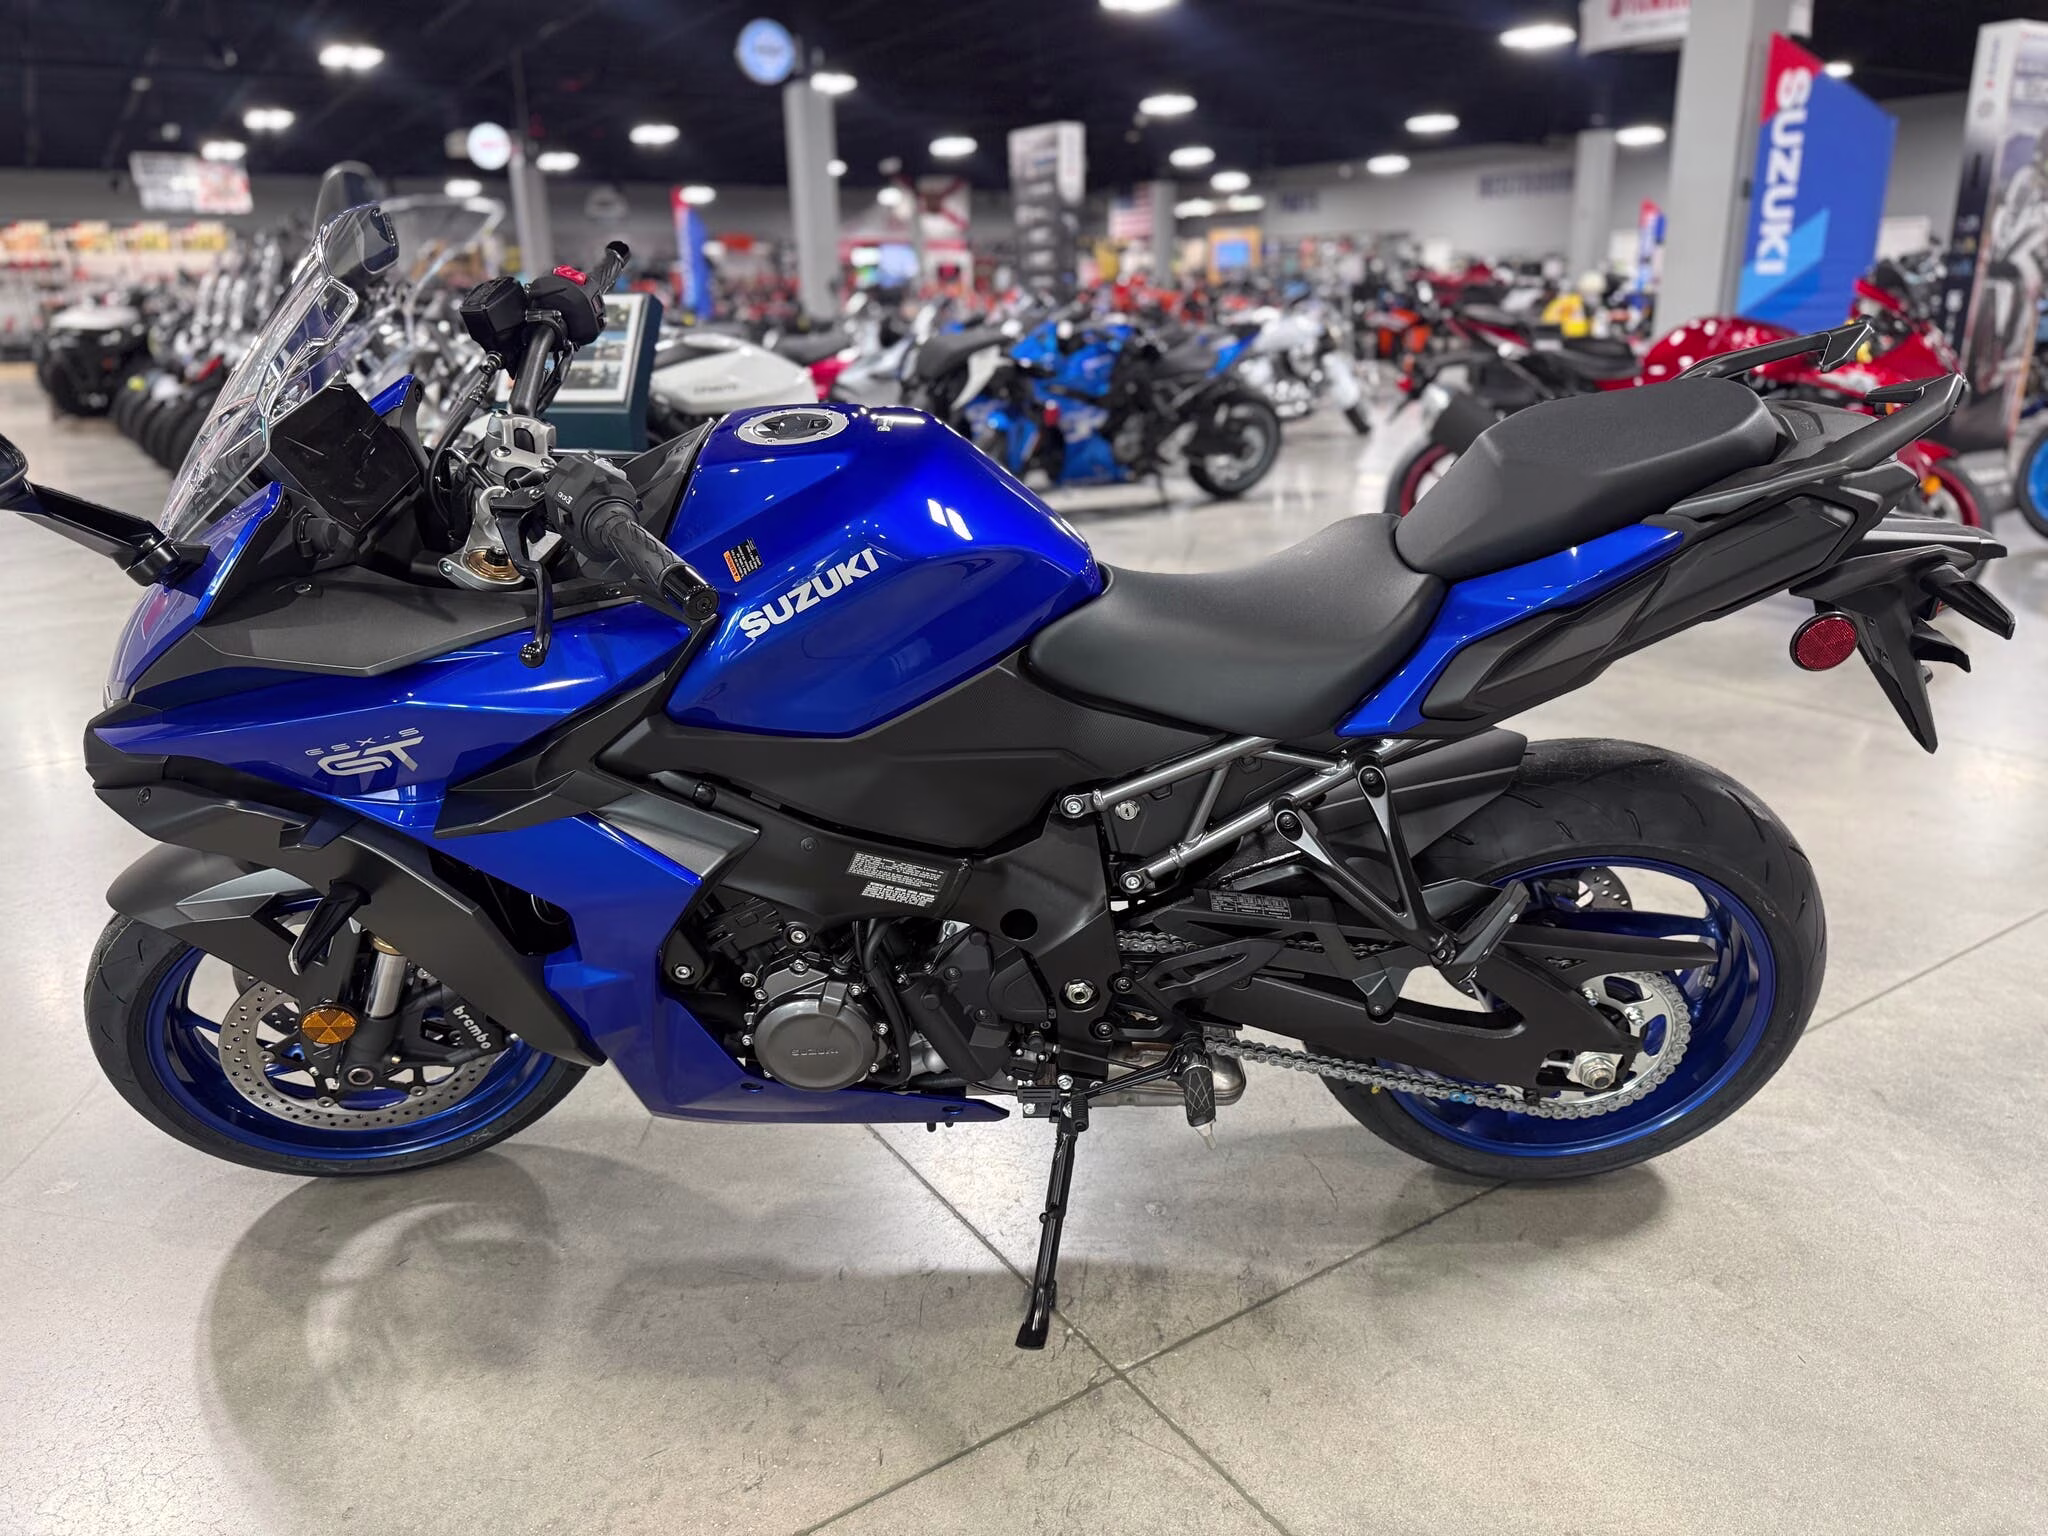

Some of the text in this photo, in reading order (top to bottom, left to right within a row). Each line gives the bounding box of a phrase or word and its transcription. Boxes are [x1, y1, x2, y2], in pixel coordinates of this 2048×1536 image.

[1755, 67, 1812, 275] SUZUKI
[740, 547, 880, 639] SUZUKI
[305, 727, 420, 756] GSX-S
[317, 736, 424, 776] GT
[452, 1005, 491, 1049] brembo
